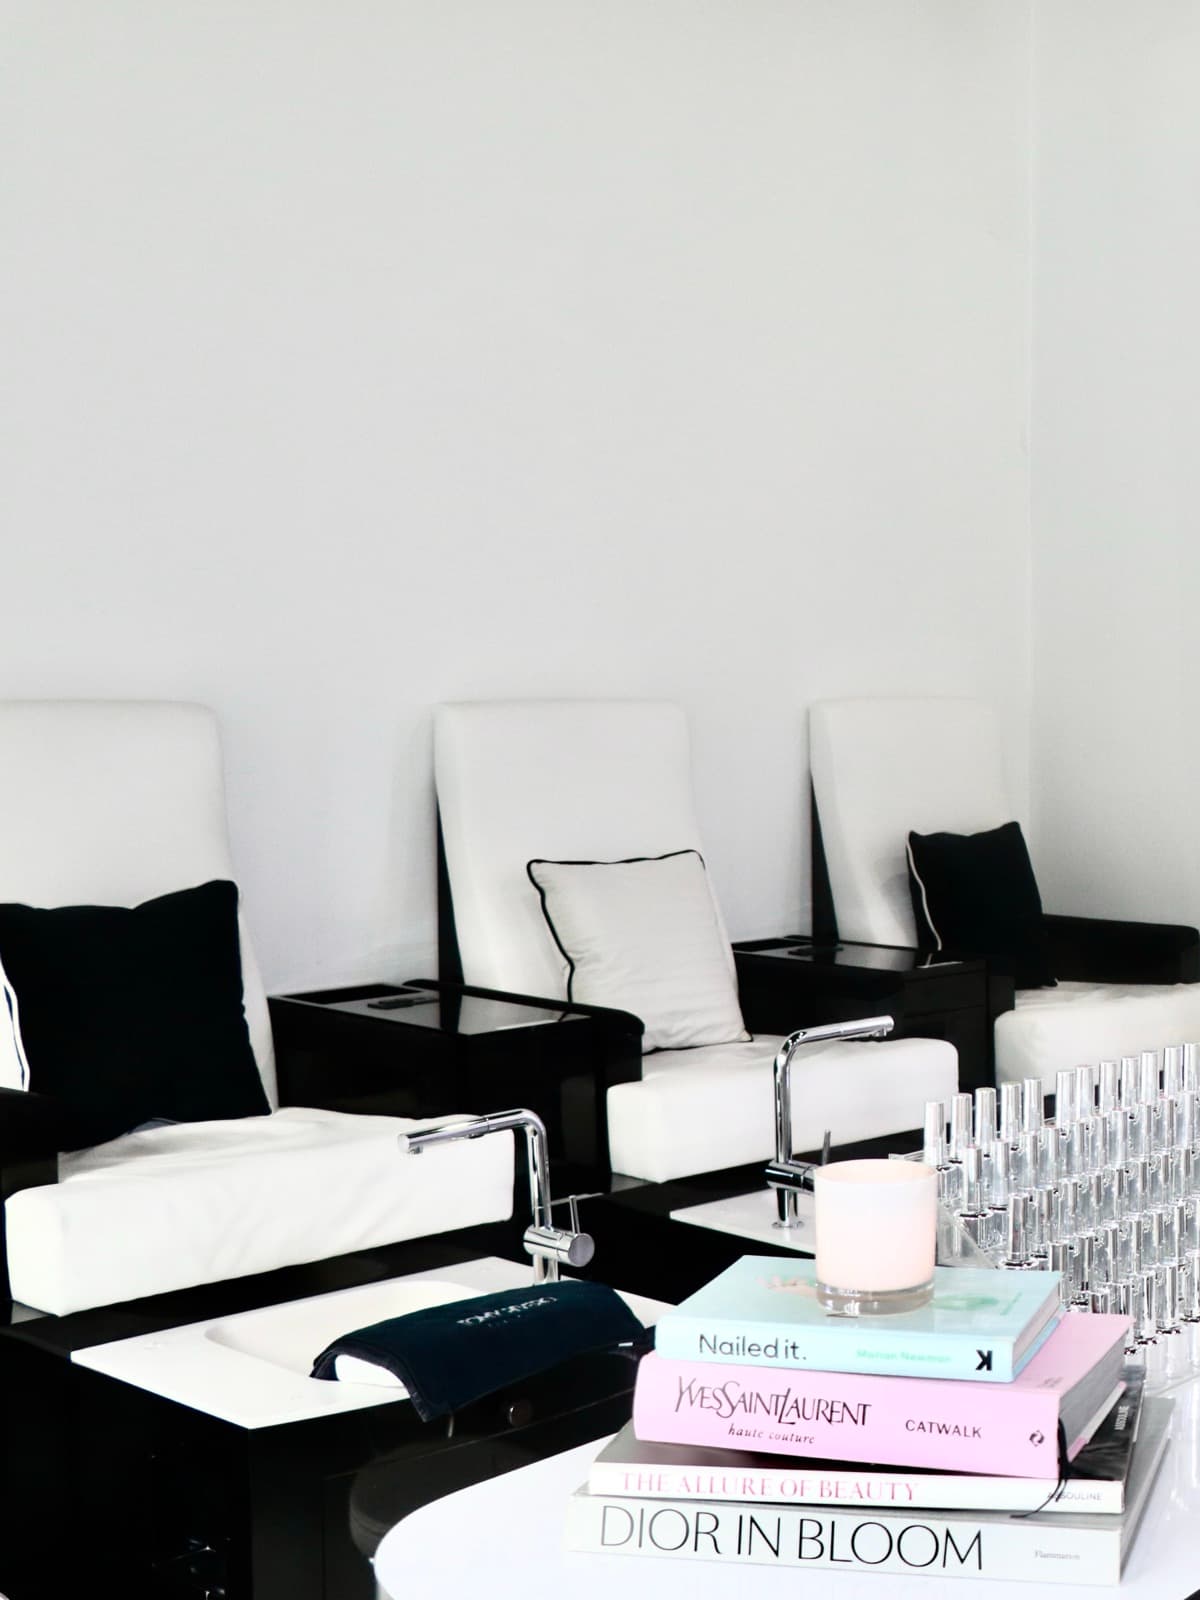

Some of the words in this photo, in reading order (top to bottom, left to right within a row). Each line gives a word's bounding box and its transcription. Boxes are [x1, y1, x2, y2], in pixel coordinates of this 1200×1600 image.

[699, 1333, 779, 1359] Nailed
[784, 1338, 808, 1361] it.
[728, 1423, 764, 1440] haute
[768, 1429, 817, 1446] couture
[905, 1419, 982, 1439] CATWALK
[621, 1472, 665, 1493] THE
[676, 1473, 774, 1497] ALLURE
[779, 1478, 808, 1498] OF
[819, 1480, 919, 1501] BEAUTY
[601, 1504, 723, 1555] DIOR
[737, 1514, 781, 1558] IN
[798, 1518, 982, 1571] BLOOM
